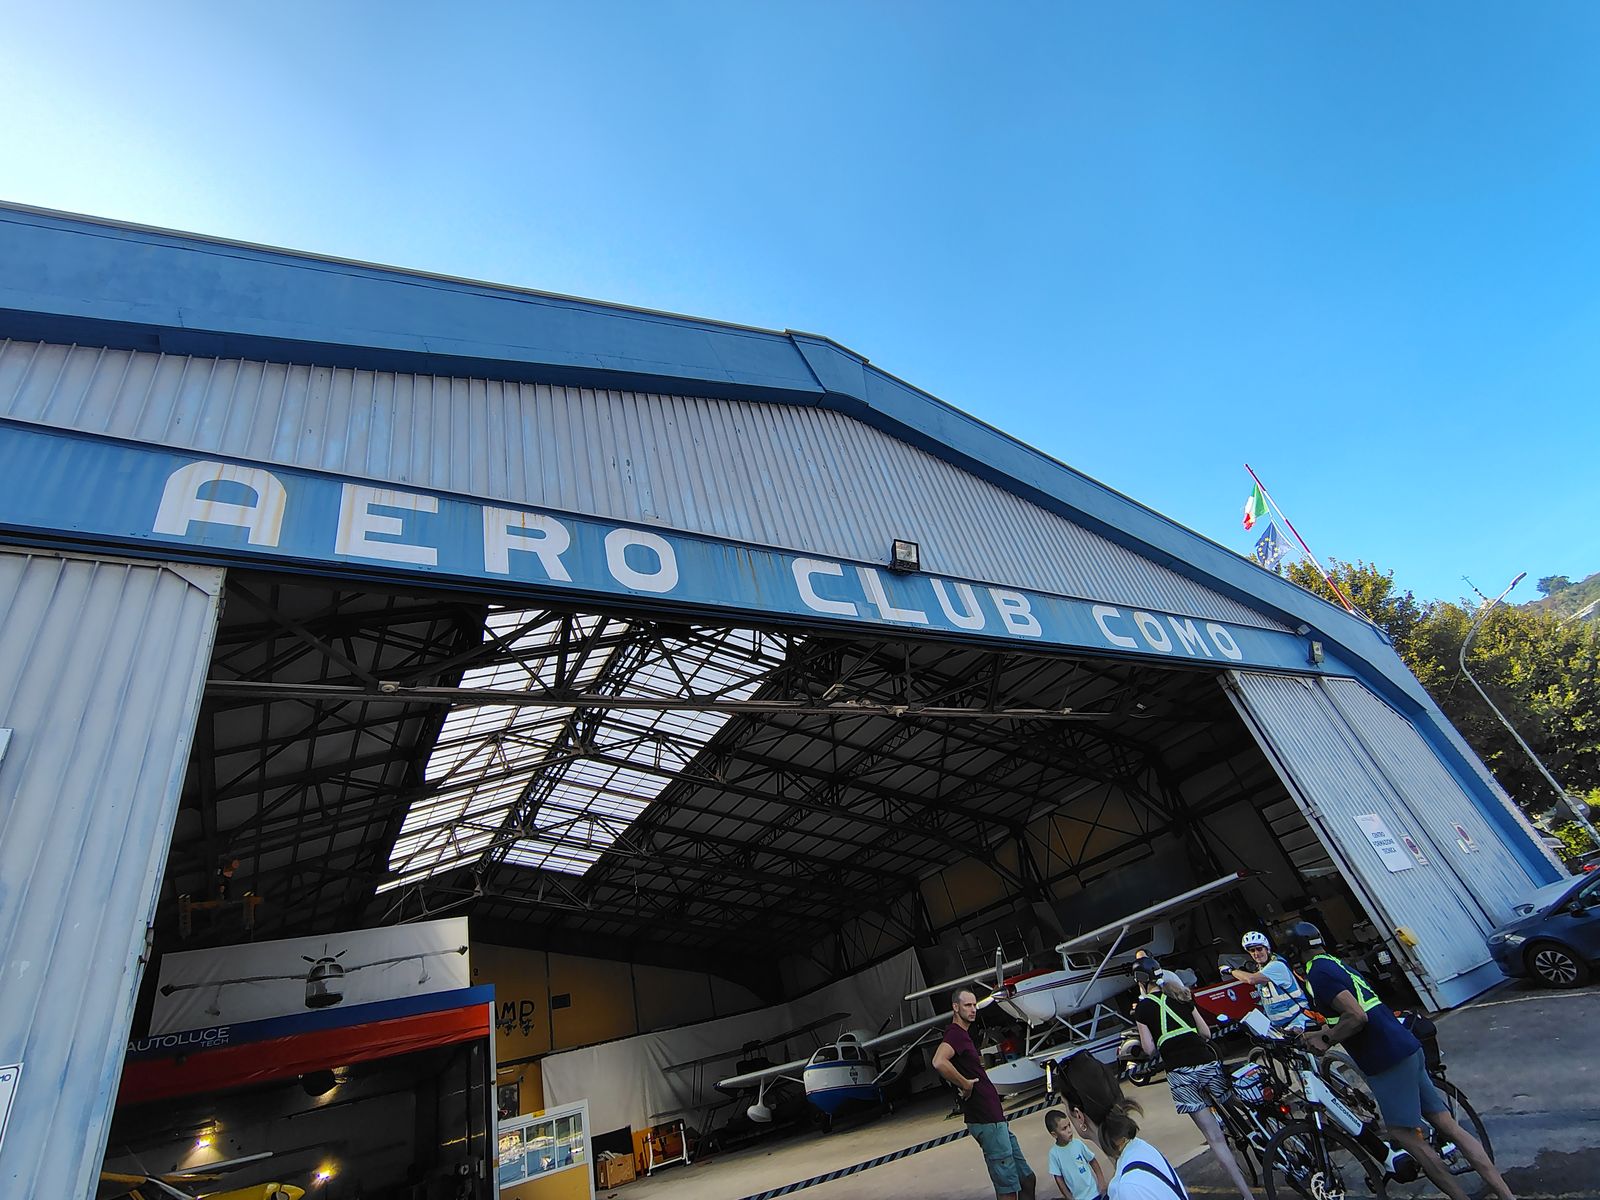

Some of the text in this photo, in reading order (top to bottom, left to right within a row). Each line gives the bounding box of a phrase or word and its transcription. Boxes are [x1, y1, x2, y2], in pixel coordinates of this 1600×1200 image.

[152, 461, 1243, 661] AERO CLUB COMO
[127, 1026, 231, 1052] AUTOLUCE
[200, 1037, 229, 1048] TECH
